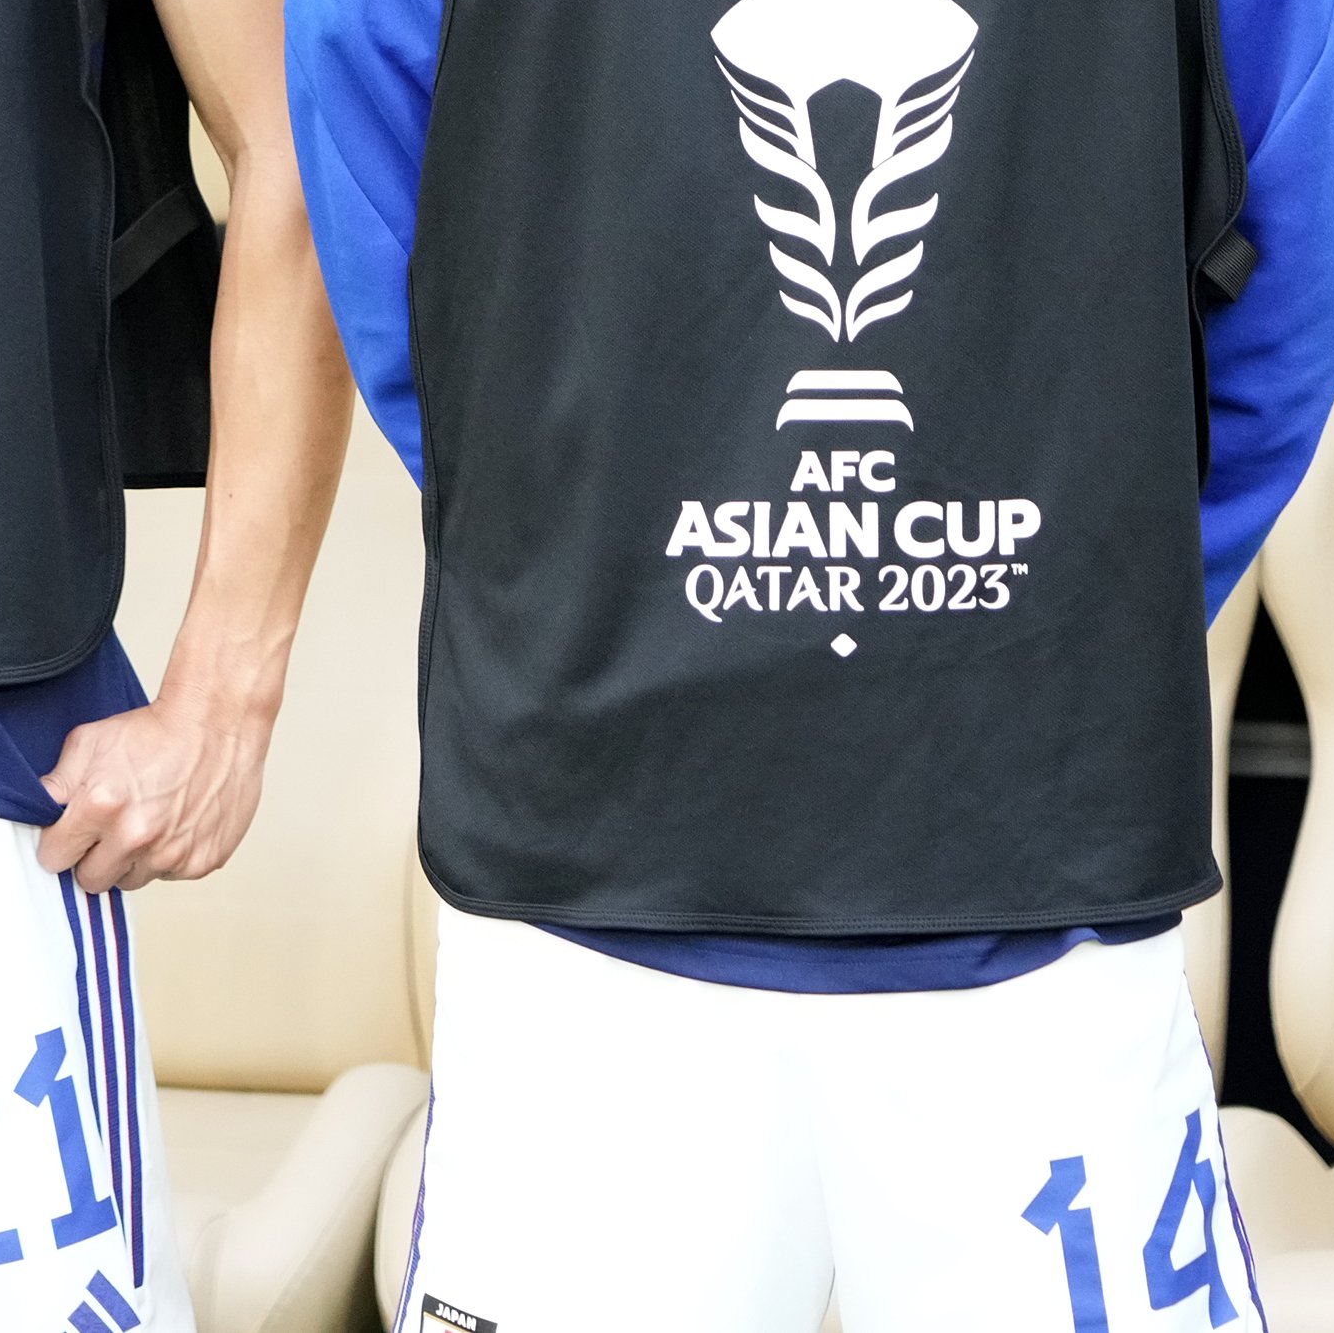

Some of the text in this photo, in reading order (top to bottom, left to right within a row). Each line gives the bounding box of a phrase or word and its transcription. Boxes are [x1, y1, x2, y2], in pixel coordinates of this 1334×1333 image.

[789, 449, 896, 493] AFC
[664, 498, 1042, 559] ASIAN CUP
[684, 563, 865, 623] QATAR
[1020, 1107, 1240, 1333] 14
[435, 1302, 477, 1332] JAPAN
